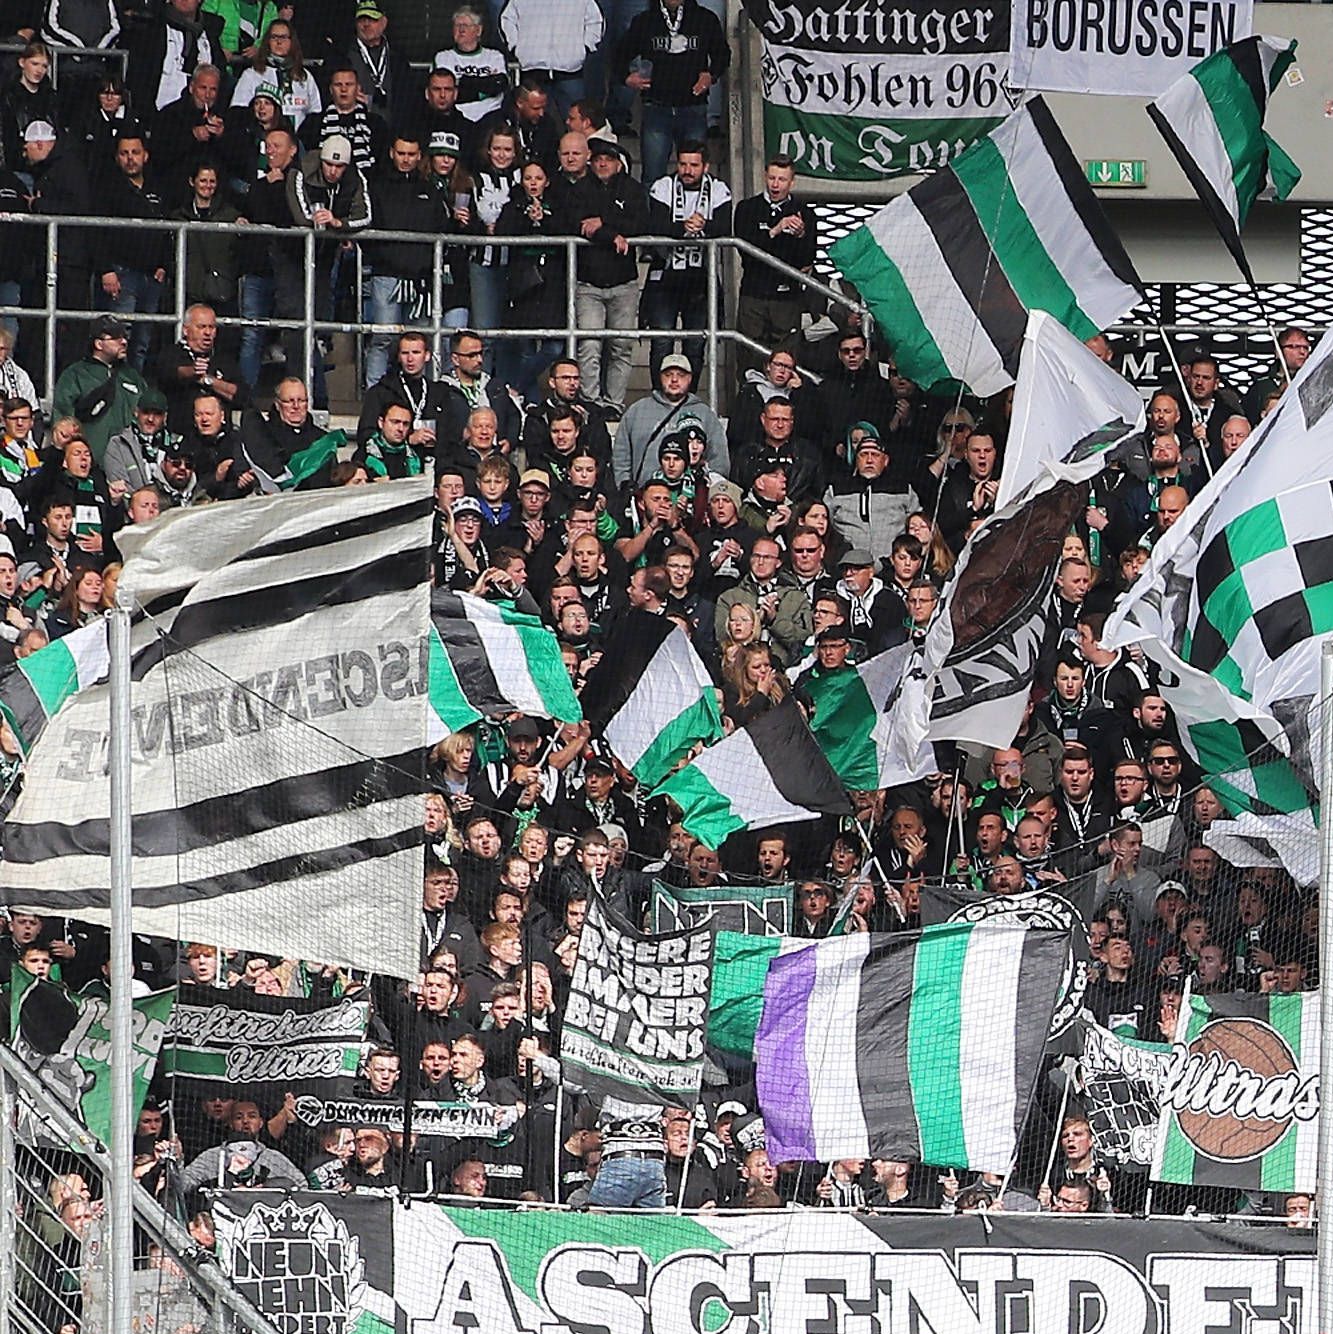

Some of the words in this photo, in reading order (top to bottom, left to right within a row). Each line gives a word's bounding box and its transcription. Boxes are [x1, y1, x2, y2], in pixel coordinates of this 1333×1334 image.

[1026, 0, 1236, 52] BORUSSEN
[781, 62, 938, 109] Fohlen
[945, 62, 997, 109] 96
[626, 1020, 704, 1059] UNS
[1157, 1040, 1321, 1122] Ultras
[234, 1240, 346, 1278] NEUN
